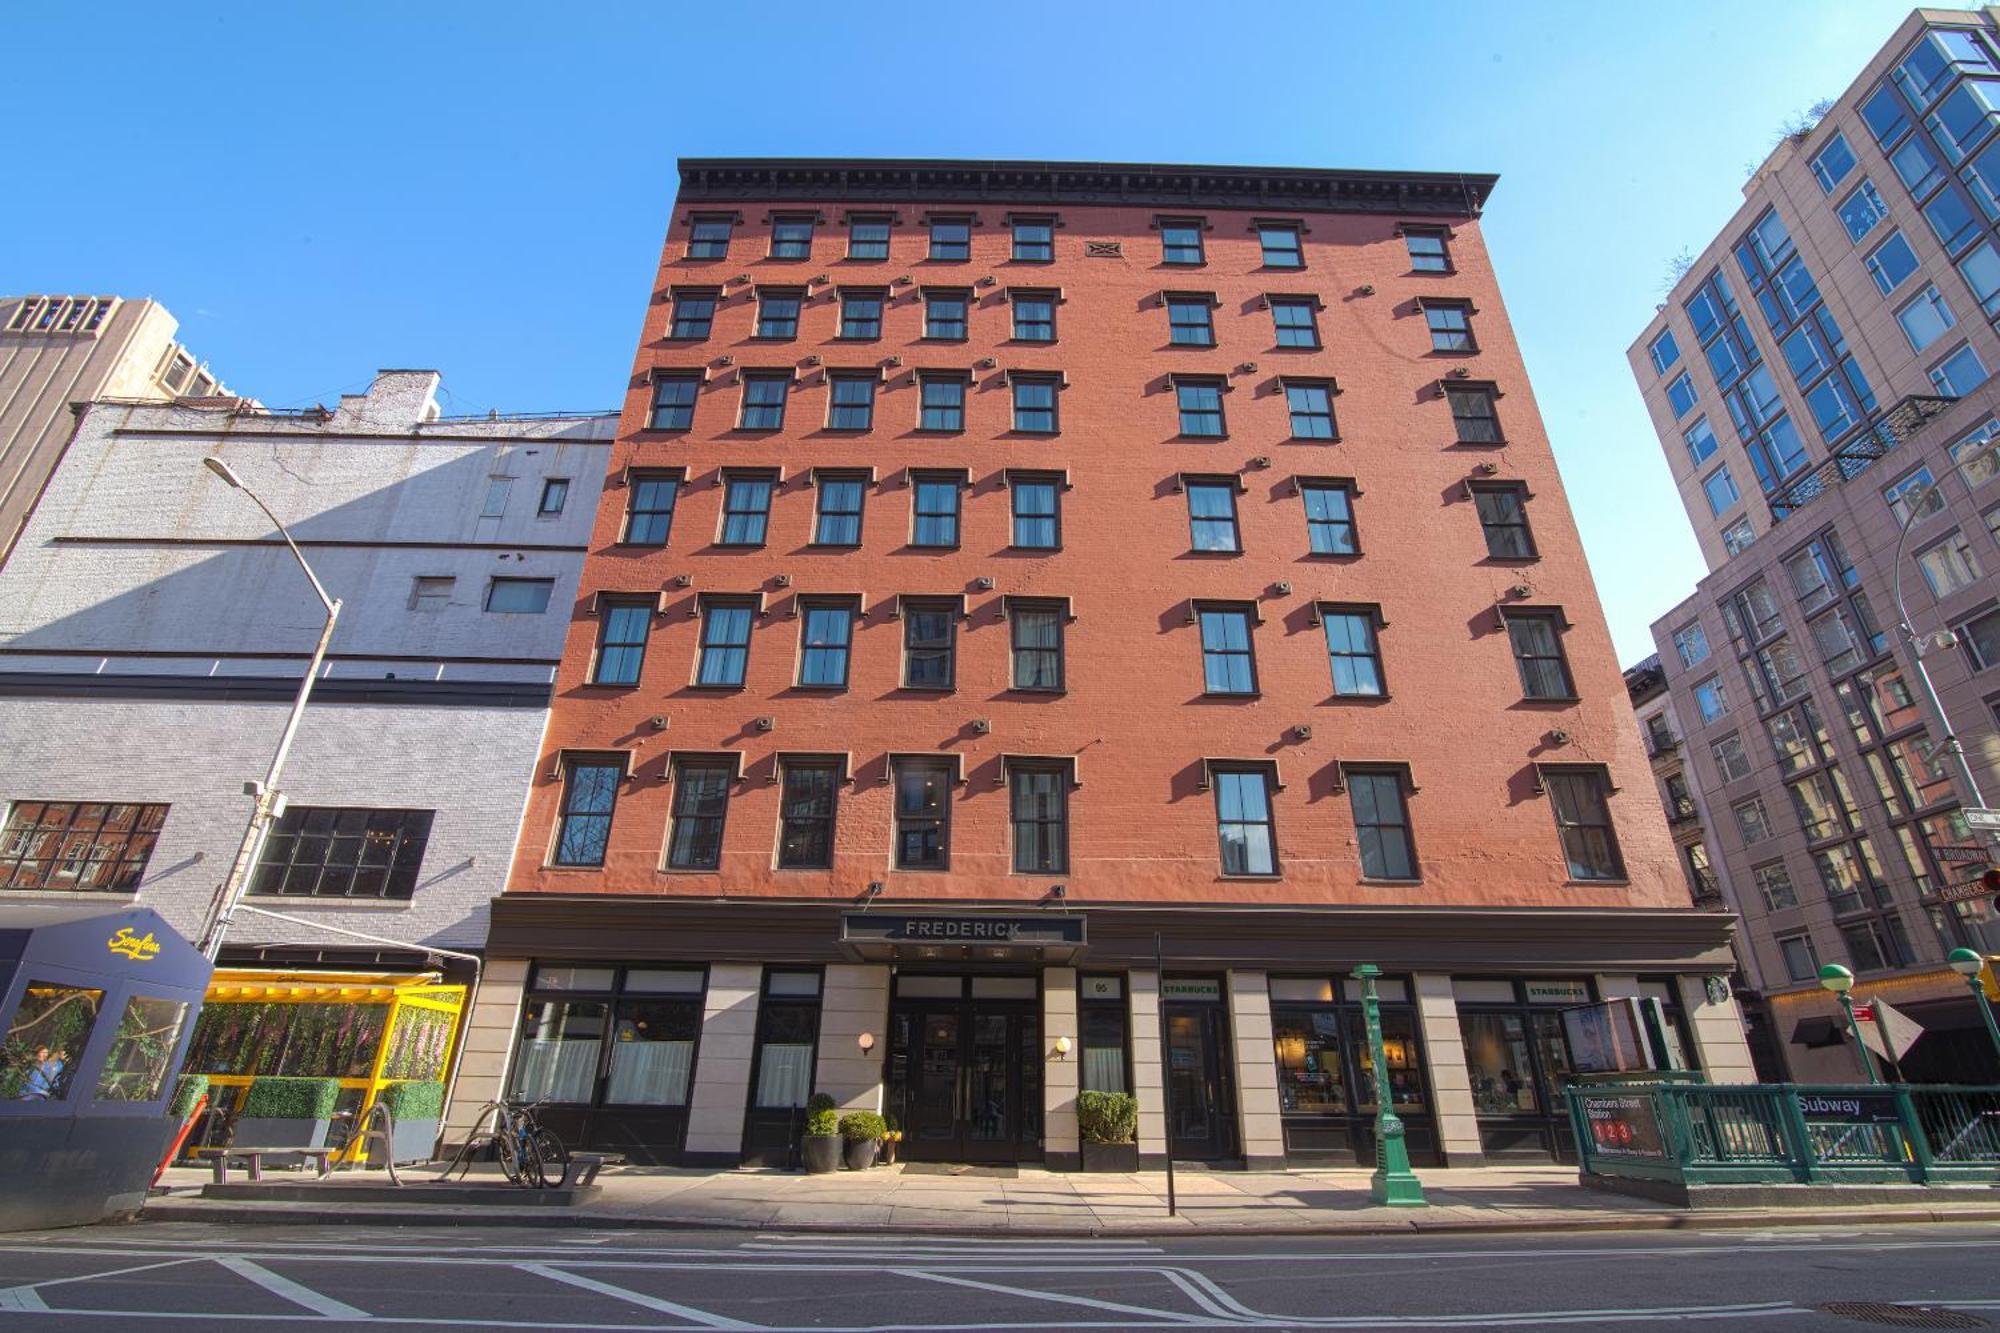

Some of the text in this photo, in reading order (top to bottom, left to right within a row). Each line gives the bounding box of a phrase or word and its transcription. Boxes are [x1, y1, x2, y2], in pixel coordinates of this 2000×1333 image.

[1943, 848, 1987, 863] BROADWAY
[1940, 880, 1985, 902] CHAMBERS
[905, 922, 1021, 937] FREDERICK
[1163, 985, 1217, 994] STARBUCKS
[1584, 1098, 1641, 1109] Chambers Street
[1798, 1097, 1860, 1115] Subway
[1587, 1109, 1612, 1119] Station
